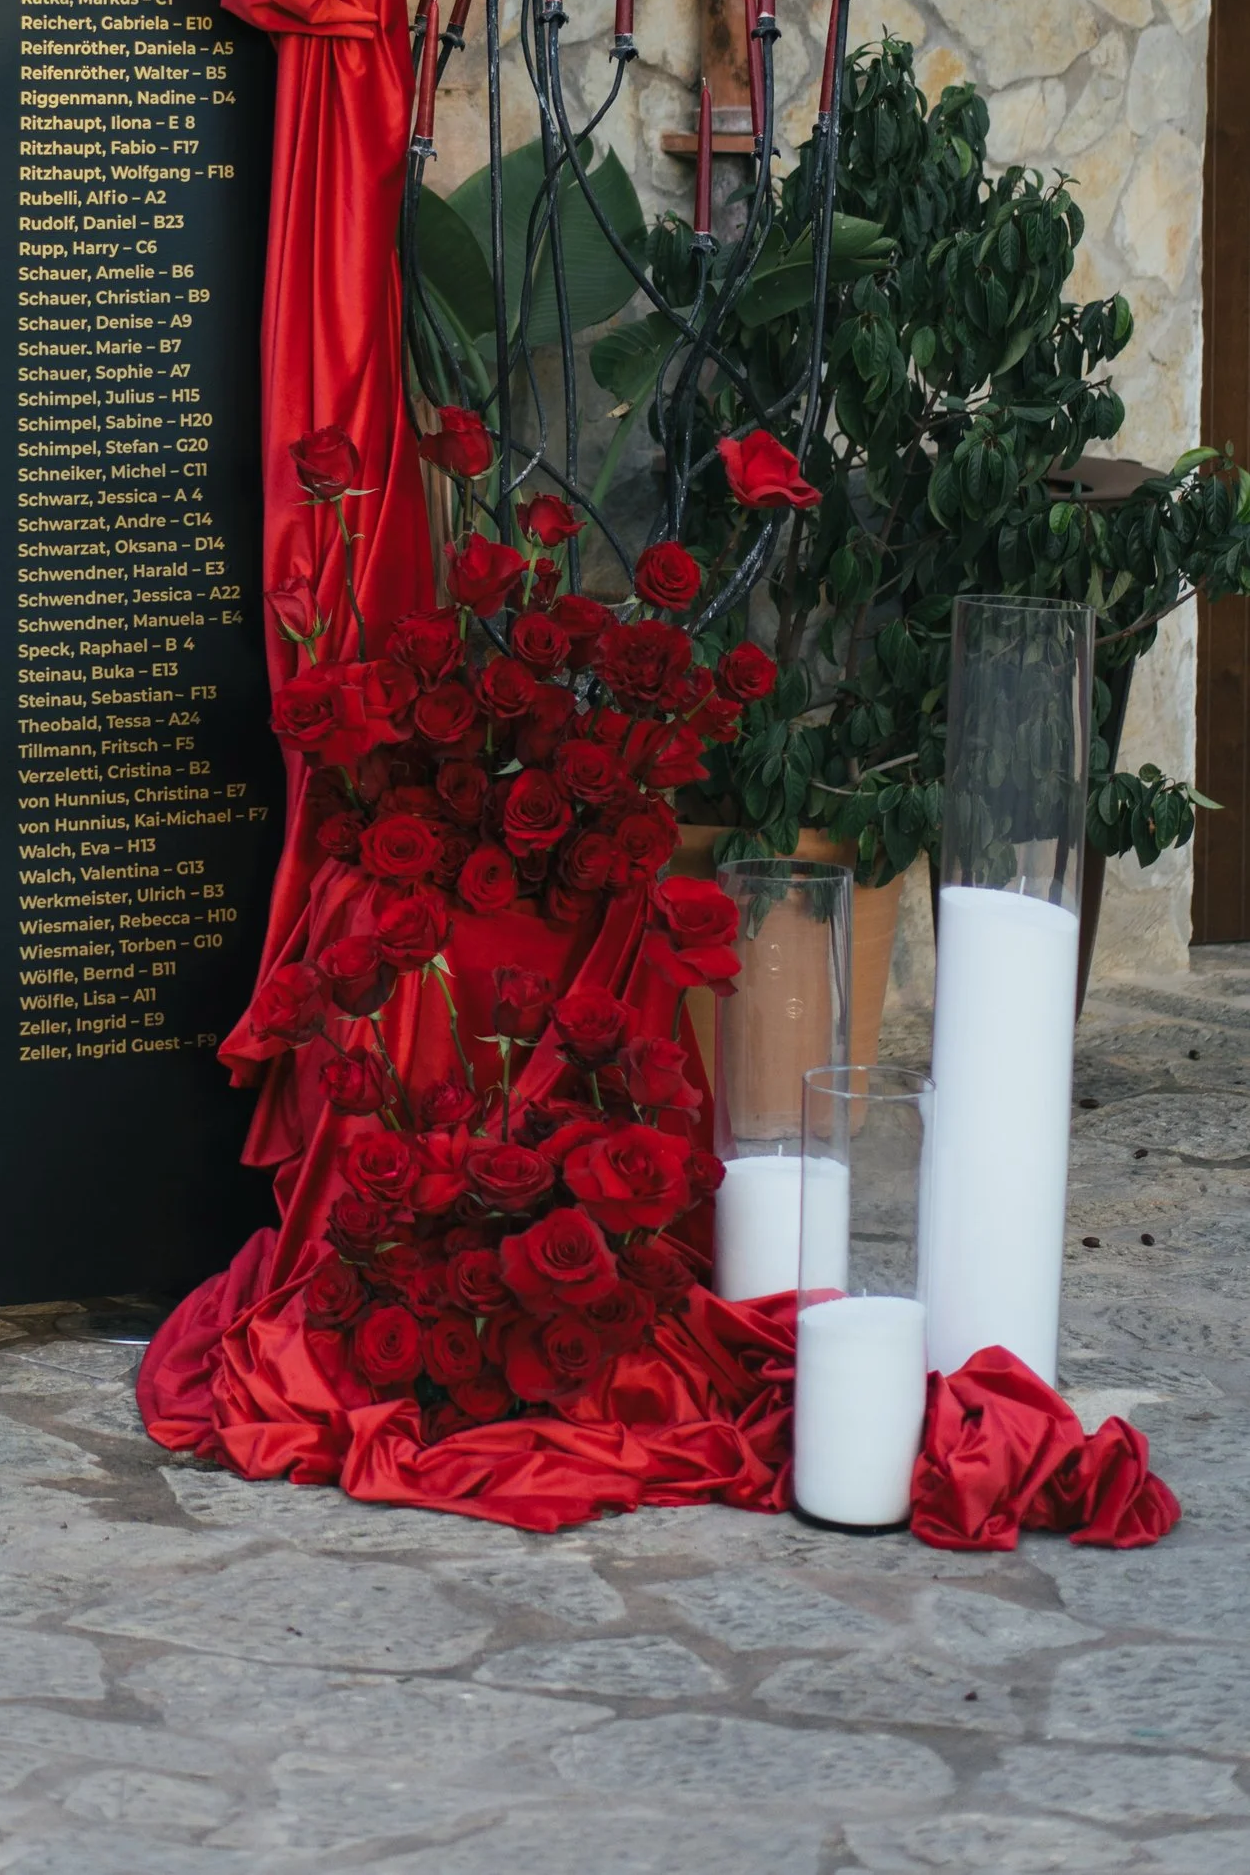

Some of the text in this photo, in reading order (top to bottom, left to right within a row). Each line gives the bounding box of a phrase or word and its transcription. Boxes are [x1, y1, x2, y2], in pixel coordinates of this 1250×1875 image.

[21, 14, 97, 33] Reichert,
[101, 15, 169, 30] Gabriela
[186, 16, 212, 30] E10
[21, 89, 133, 108] Riggenmann,
[137, 89, 196, 105] Nadine
[213, 90, 236, 105] D4
[19, 215, 79, 233] Rudolf,
[83, 214, 136, 230] Daniel
[154, 215, 184, 229] B23
[18, 291, 92, 308] Schauer,
[96, 288, 171, 305] Christian
[188, 289, 210, 303] B9
[18, 415, 101, 434] Schimpel,
[105, 413, 163, 429] Sabine
[180, 413, 213, 427] H20
[18, 765, 103, 784] Verzeletti,
[107, 762, 171, 779] Cristina
[189, 760, 211, 775] B2
[19, 918, 115, 935] Wiesmaier,
[120, 912, 190, 929] Rebecca
[208, 908, 237, 923] H10
[19, 993, 79, 1010] Wölfle,
[83, 990, 116, 1006] Lisa
[133, 987, 156, 1003] A11
